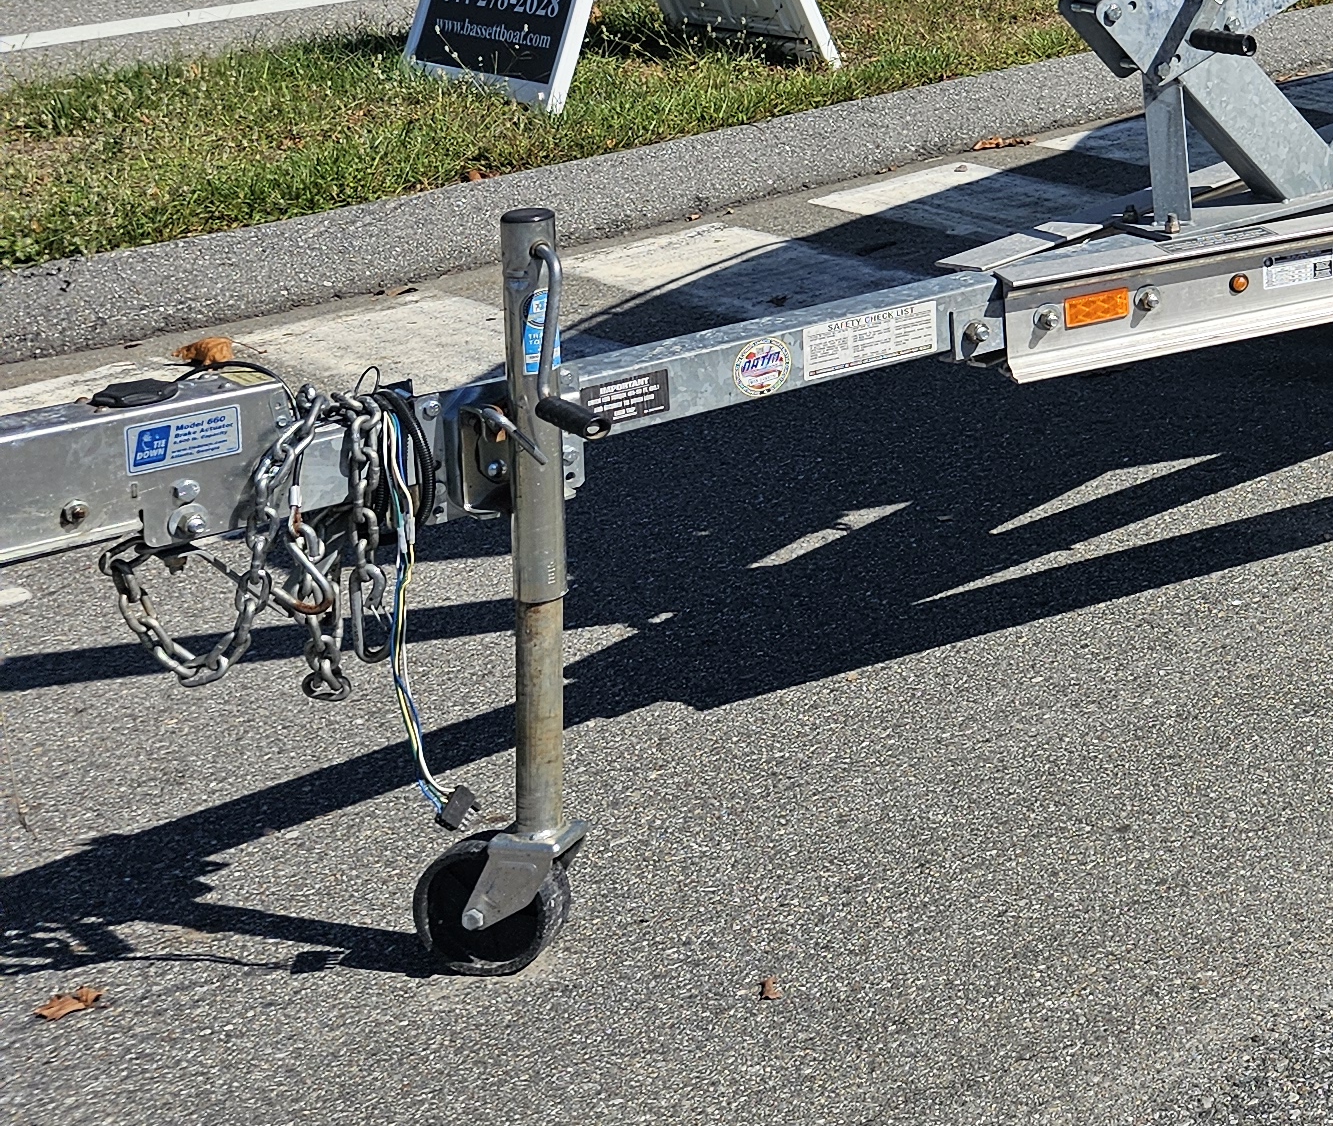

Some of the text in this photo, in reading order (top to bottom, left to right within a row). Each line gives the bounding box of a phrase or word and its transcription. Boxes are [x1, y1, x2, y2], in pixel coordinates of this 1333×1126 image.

[436, 17, 551, 49] www.bassettboat.com
[827, 306, 915, 332] SAFETY CHECK LIST
[175, 420, 204, 432] Model
[153, 438, 167, 449] TIE
[136, 447, 165, 460] DOWN
